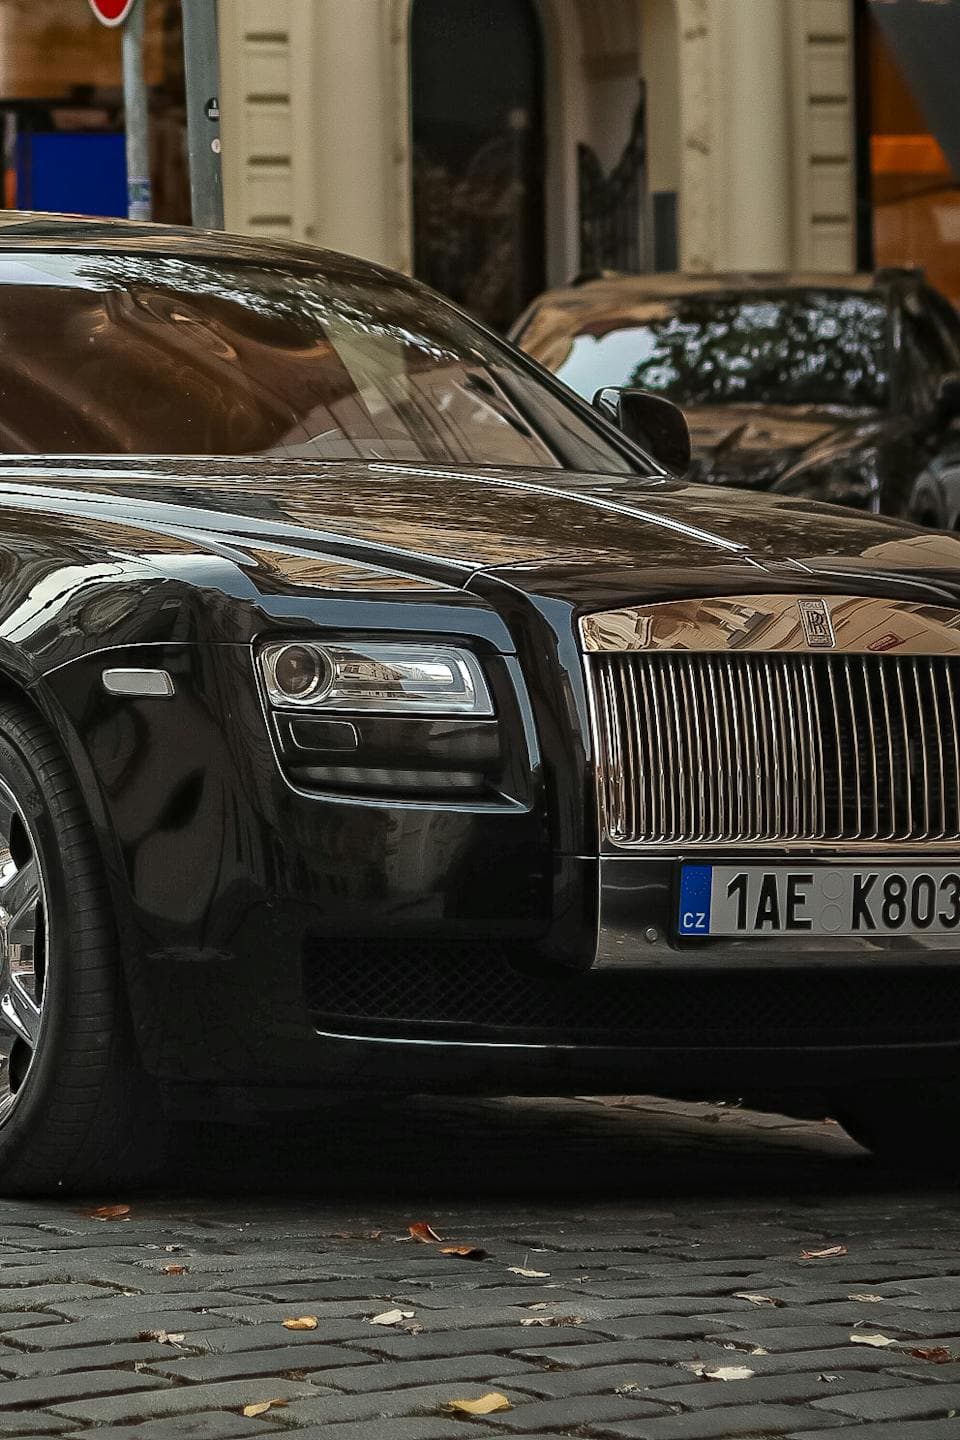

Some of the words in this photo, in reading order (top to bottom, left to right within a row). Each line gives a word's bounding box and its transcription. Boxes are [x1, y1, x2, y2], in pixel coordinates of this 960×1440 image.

[727, 873, 814, 930] 1AE
[852, 873, 960, 930] K803
[683, 913, 706, 928] CZ
